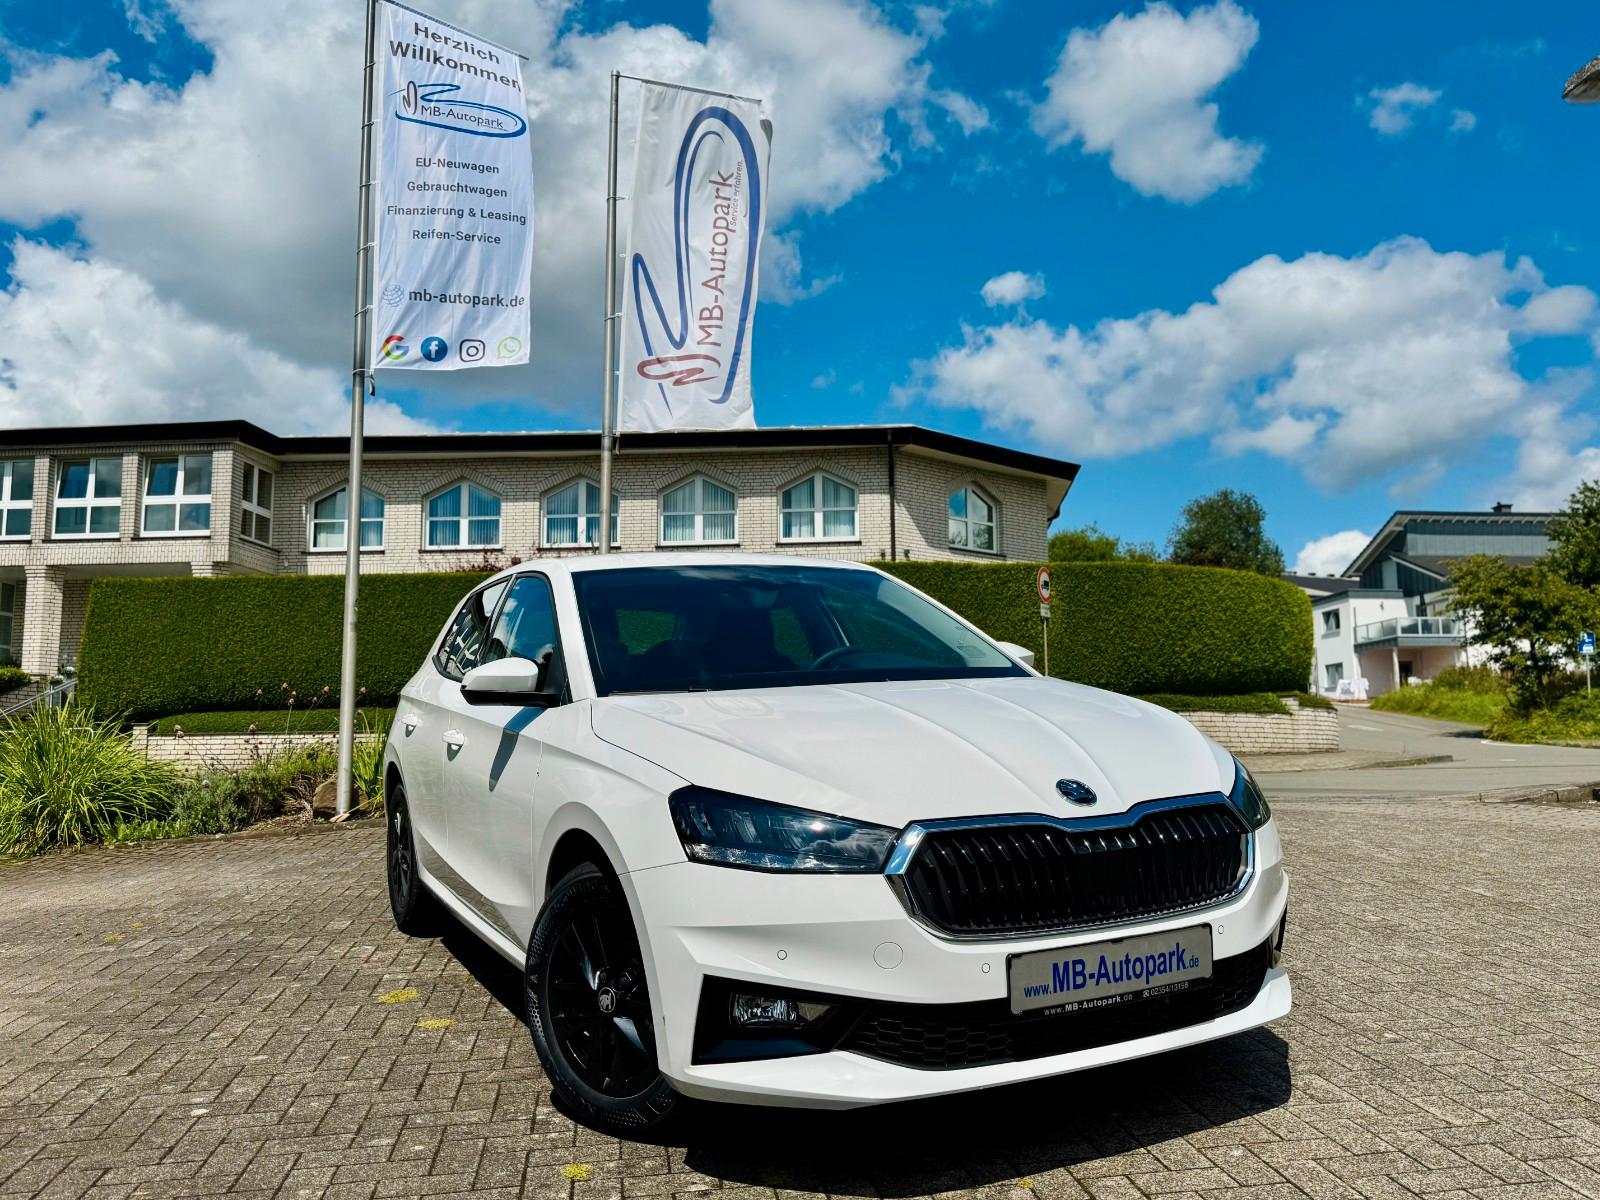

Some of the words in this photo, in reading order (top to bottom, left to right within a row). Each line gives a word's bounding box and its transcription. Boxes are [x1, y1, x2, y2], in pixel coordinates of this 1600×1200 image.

[414, 22, 500, 65] Herzlich
[390, 40, 521, 93] Willkommen
[421, 104, 504, 129] MB-Autopark
[415, 157, 500, 174] EU-Neuwagen
[407, 181, 508, 198] Gebrauchtwagen
[387, 205, 465, 219] Finanzierung
[467, 207, 477, 218] &
[480, 208, 527, 226] Leasing
[412, 229, 502, 245] Reifen-Service
[697, 169, 737, 347] MB-Autopark
[408, 288, 526, 308] mb-autopark.de
[1024, 942, 1200, 998] www.MB-Autopark.de
[1044, 994, 1133, 1016] www.MB-Autopark.de
